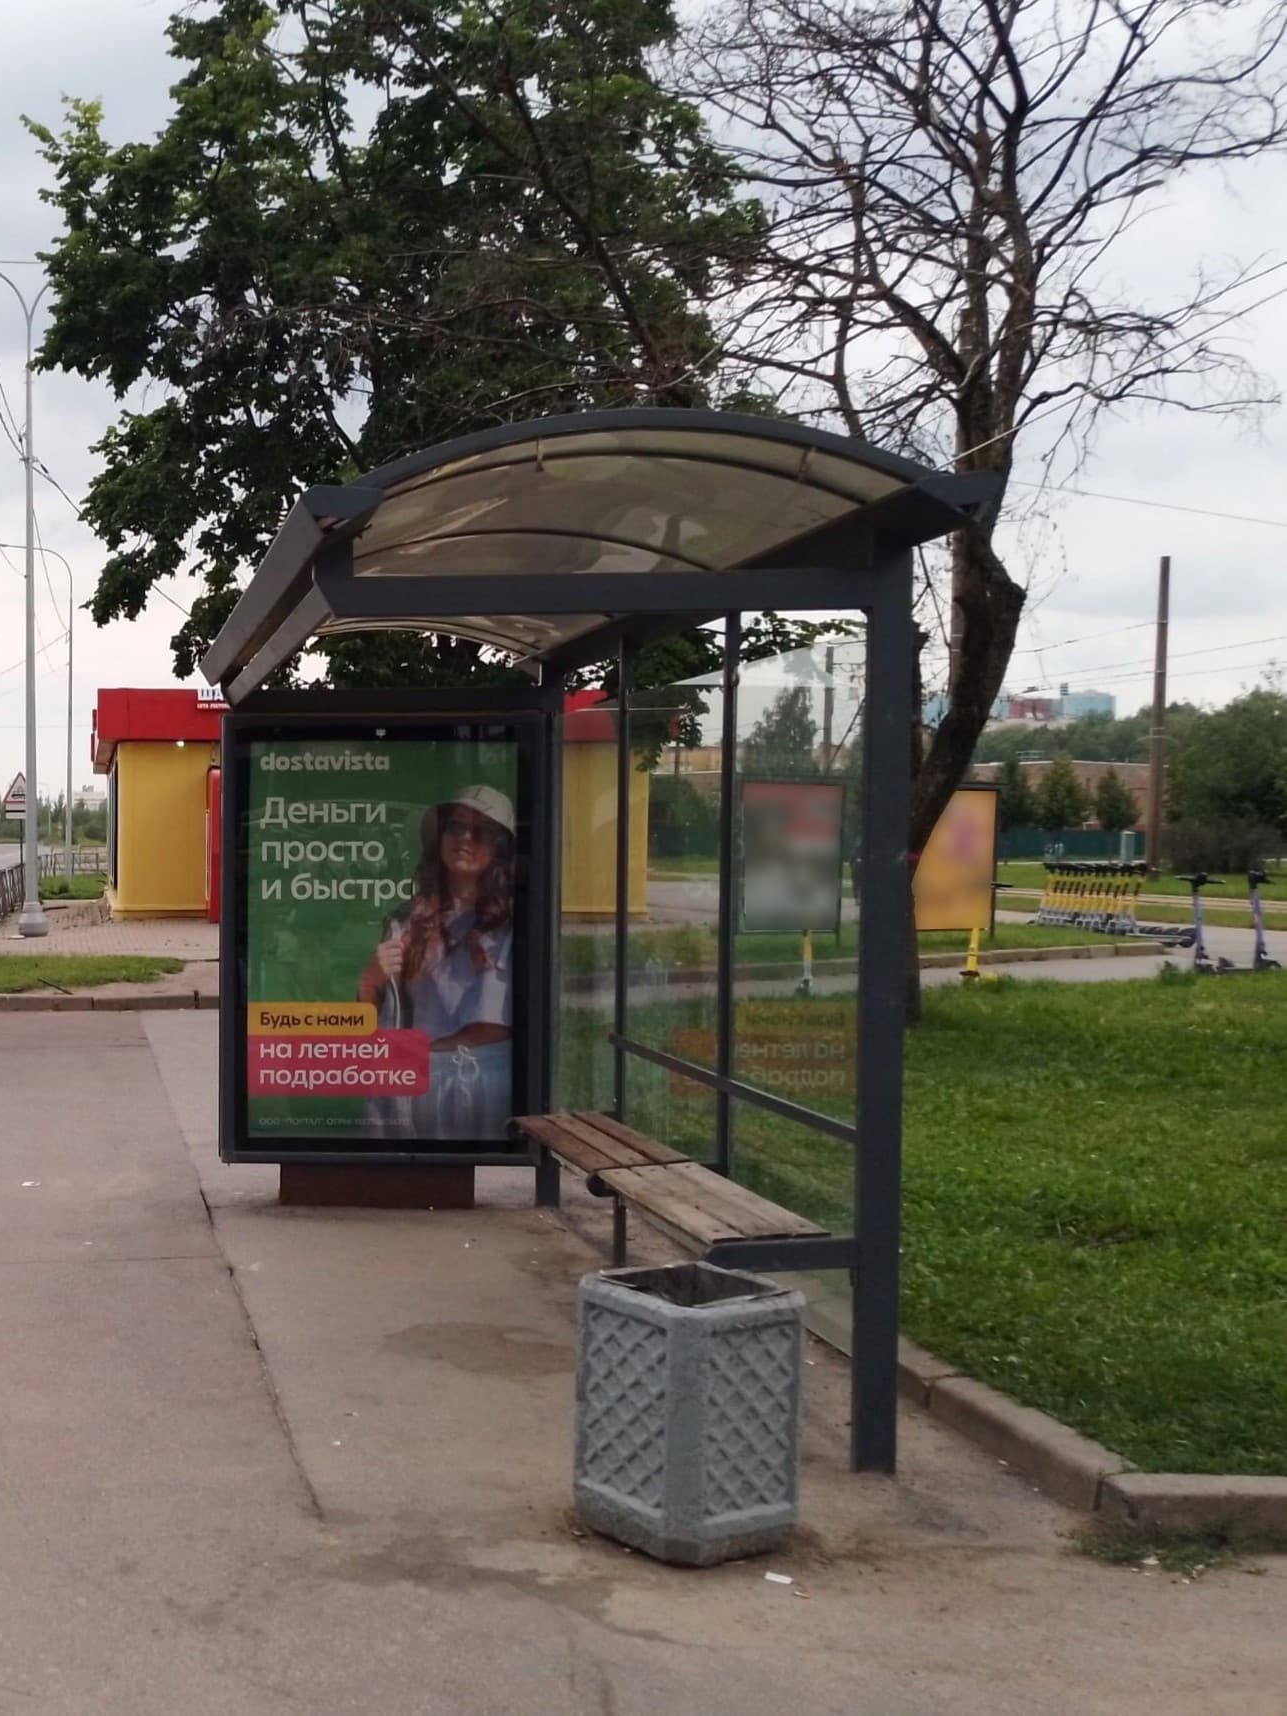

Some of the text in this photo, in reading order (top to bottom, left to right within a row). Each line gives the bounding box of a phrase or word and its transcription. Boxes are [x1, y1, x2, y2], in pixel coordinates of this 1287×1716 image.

[260, 751, 390, 771] dostavista
[260, 797, 387, 829] Деньги
[261, 840, 385, 869] просто
[261, 873, 418, 907] и быстро
[260, 1012, 365, 1029] Будь с нами
[259, 1037, 390, 1060] на летней
[259, 1065, 417, 1090] подработке
